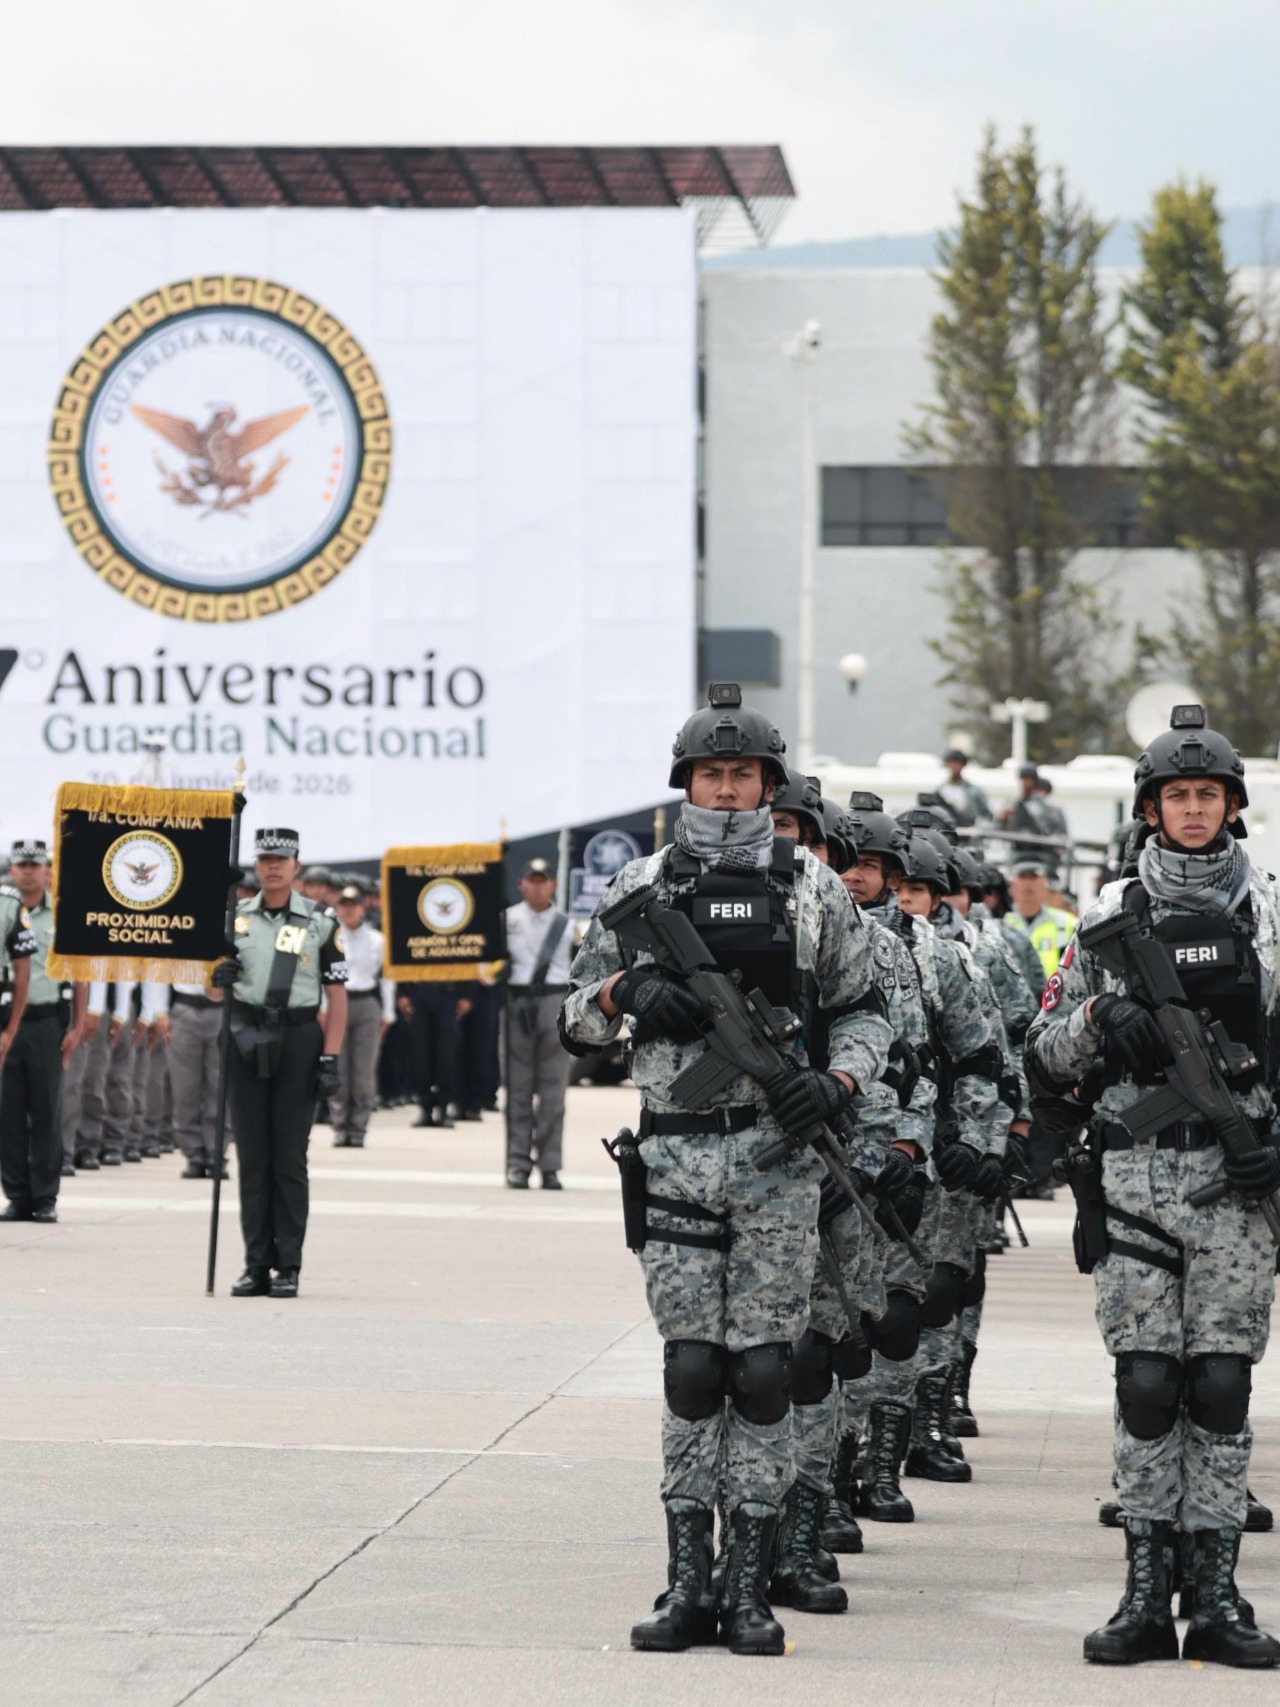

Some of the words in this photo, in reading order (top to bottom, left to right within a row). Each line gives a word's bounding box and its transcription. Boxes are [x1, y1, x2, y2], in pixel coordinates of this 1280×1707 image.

[101, 325, 210, 427] GUARDIA
[219, 324, 337, 428] NACIONAL
[46, 648, 484, 708] Aniversario
[266, 714, 486, 758] Nacional
[248, 770, 278, 794] de
[291, 772, 352, 795] 2026
[86, 912, 195, 930] PROXIMIDAD
[710, 903, 752, 918] FERI
[108, 928, 173, 944] SOCIAL
[275, 924, 308, 956] GN
[1175, 945, 1218, 964] FERI
